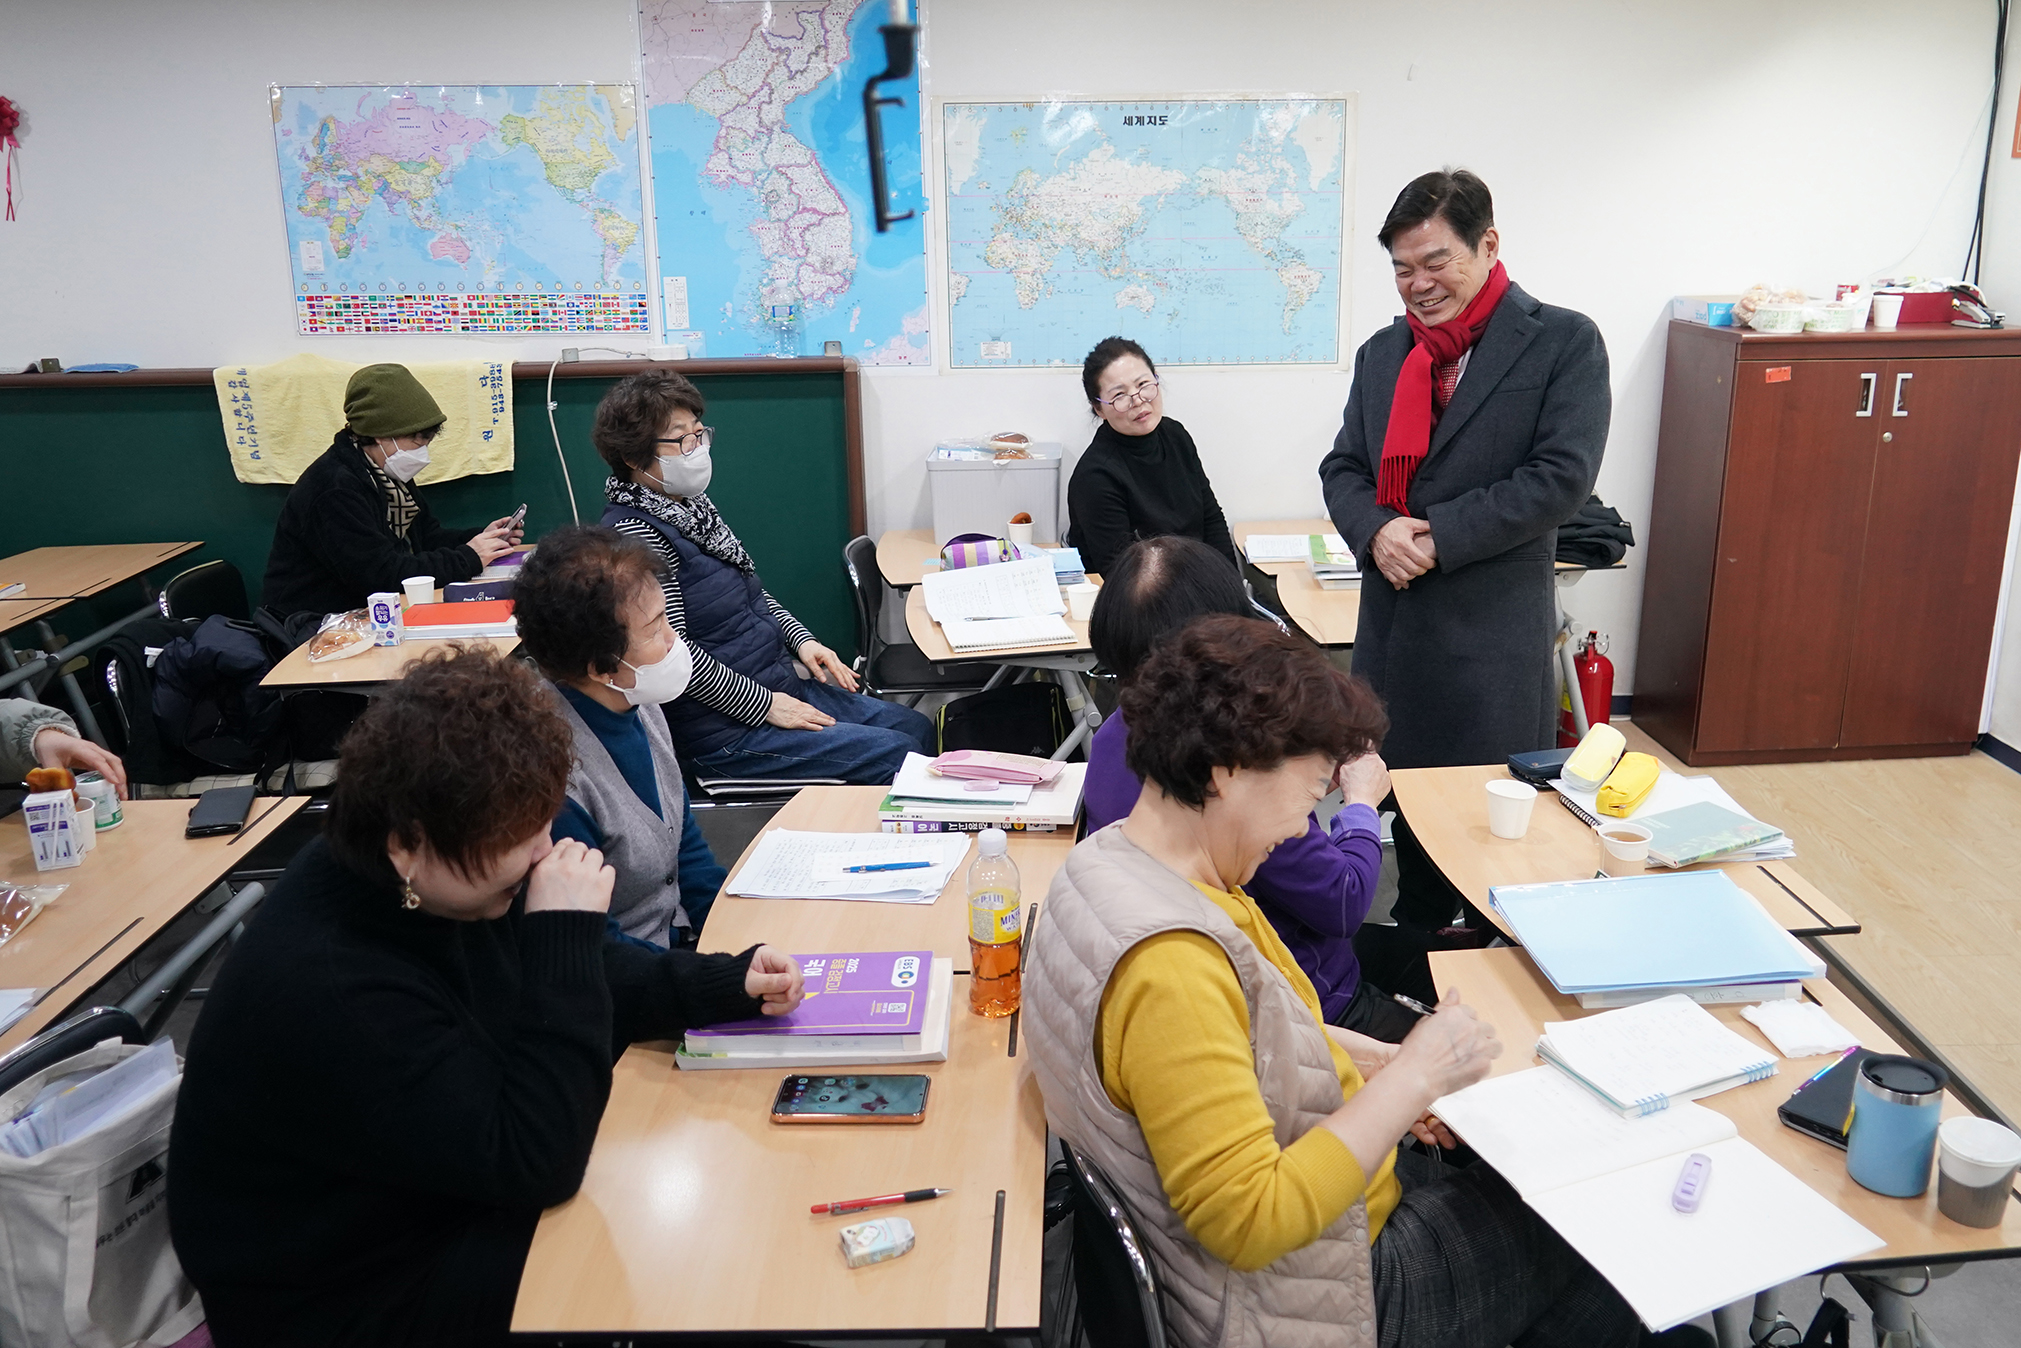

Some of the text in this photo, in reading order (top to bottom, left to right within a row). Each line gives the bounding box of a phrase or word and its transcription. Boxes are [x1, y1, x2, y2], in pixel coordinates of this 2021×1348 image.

[1122, 115, 1169, 126] 세계지도
[917, 822, 939, 832] 국어
[802, 959, 827, 977] 국어
[845, 957, 860, 973] 2025
[902, 958, 914, 970] EBS
[825, 958, 847, 992] 중졸 검정고시
